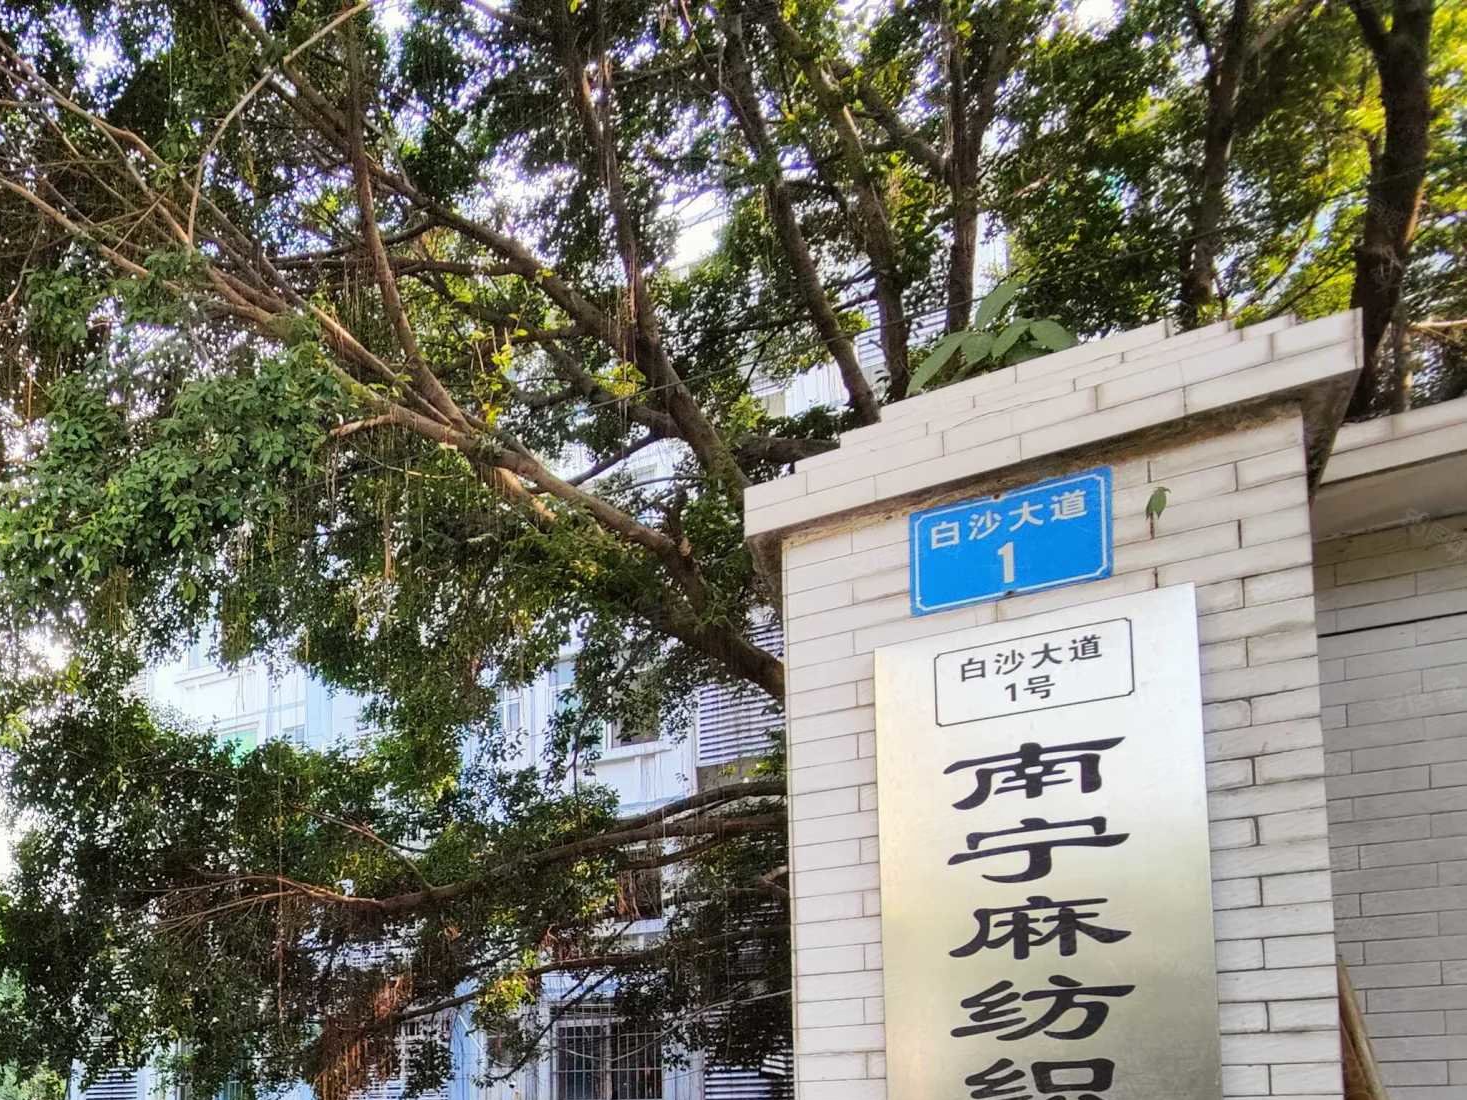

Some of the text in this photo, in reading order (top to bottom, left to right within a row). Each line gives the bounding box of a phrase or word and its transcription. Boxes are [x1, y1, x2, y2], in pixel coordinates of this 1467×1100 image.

[929, 489, 1088, 551] 白沙大道
[996, 542, 1016, 584] 1
[959, 634, 1103, 683] 白沙大道
[1004, 674, 1057, 704] 1号
